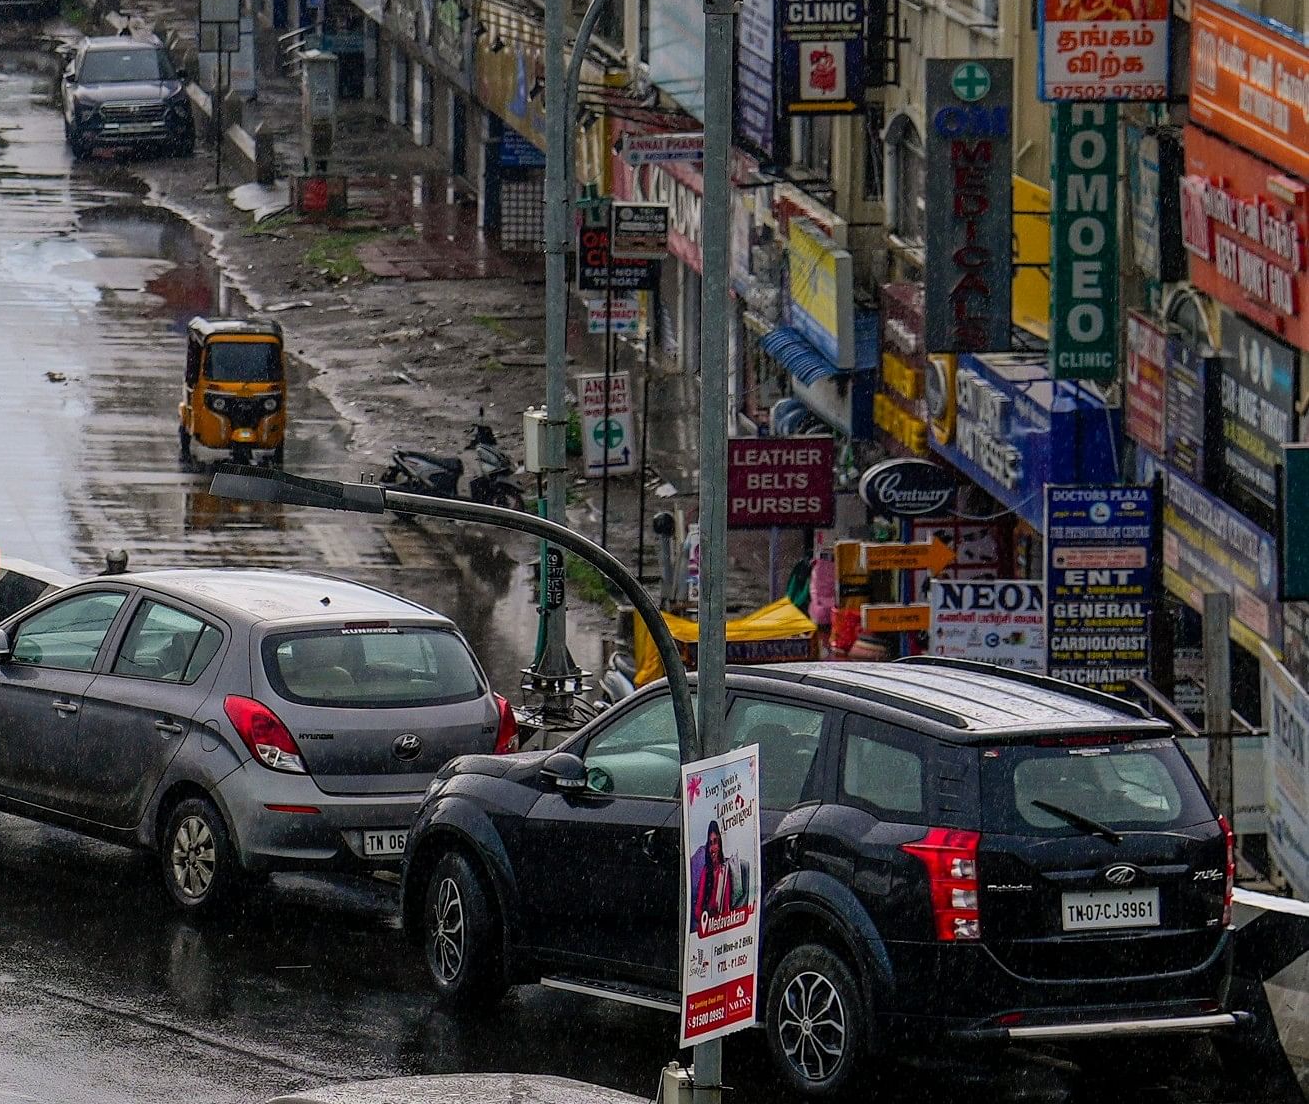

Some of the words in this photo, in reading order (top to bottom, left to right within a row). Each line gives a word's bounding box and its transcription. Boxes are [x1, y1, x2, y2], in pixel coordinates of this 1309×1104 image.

[788, 2, 858, 23] CLINIC
[1057, 24, 1155, 53] தங்கம்
[1067, 50, 1144, 80] விற்க
[1053, 85, 1107, 97] 97502
[1112, 84, 1165, 97] 97502
[950, 141, 992, 348] MEDICALS
[1059, 353, 1113, 368] CLINIC
[733, 449, 822, 466] LEATHER
[747, 473, 808, 490] BELTS
[1052, 490, 1108, 502] DOCTORS
[1110, 490, 1148, 501] PLAZA
[733, 497, 822, 514] PURSES
[1065, 569, 1134, 585] ENT
[1053, 604, 1146, 618] GENERAL
[1051, 636, 1148, 651] CARDIOLOGIST
[705, 784, 720, 799] Every
[389, 834, 405, 849] 06
[1068, 900, 1153, 922] TN-07-CJ-9961
[708, 909, 745, 933] Medavakkam
[692, 1011, 708, 1029] 91500
[709, 1007, 725, 1024] 09952
